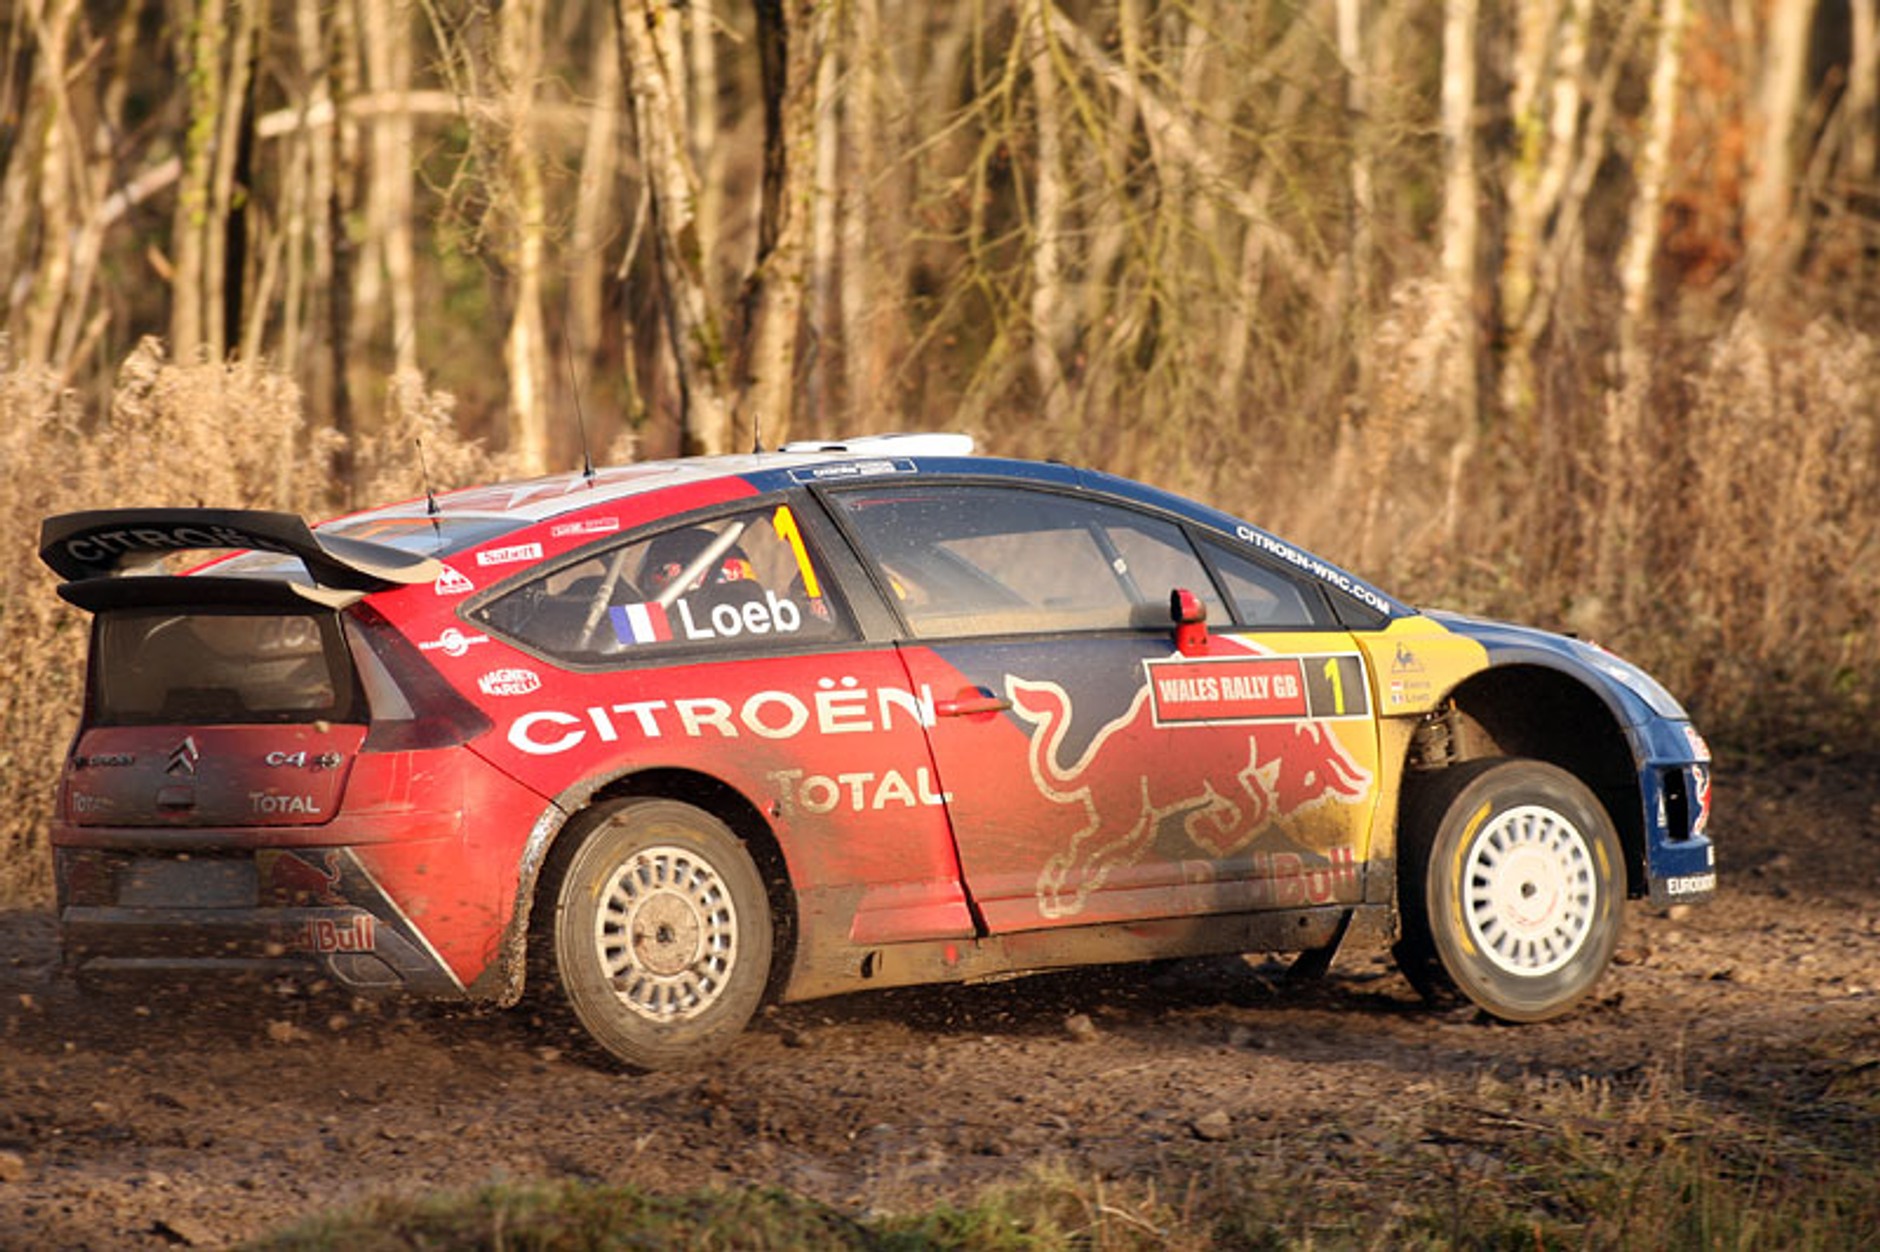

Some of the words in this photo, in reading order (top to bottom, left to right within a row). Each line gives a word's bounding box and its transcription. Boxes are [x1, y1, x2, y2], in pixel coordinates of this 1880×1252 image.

[773, 505, 822, 599] 1
[677, 590, 801, 640] Loeb
[1158, 678, 1220, 704] WALES
[1221, 675, 1272, 700] RALLY
[1273, 674, 1299, 699] GB
[1323, 657, 1345, 716] 1
[507, 675, 938, 755] CITROËN
[265, 751, 306, 768] C4
[1271, 847, 1356, 906] Bull
[317, 913, 375, 953] Bull
